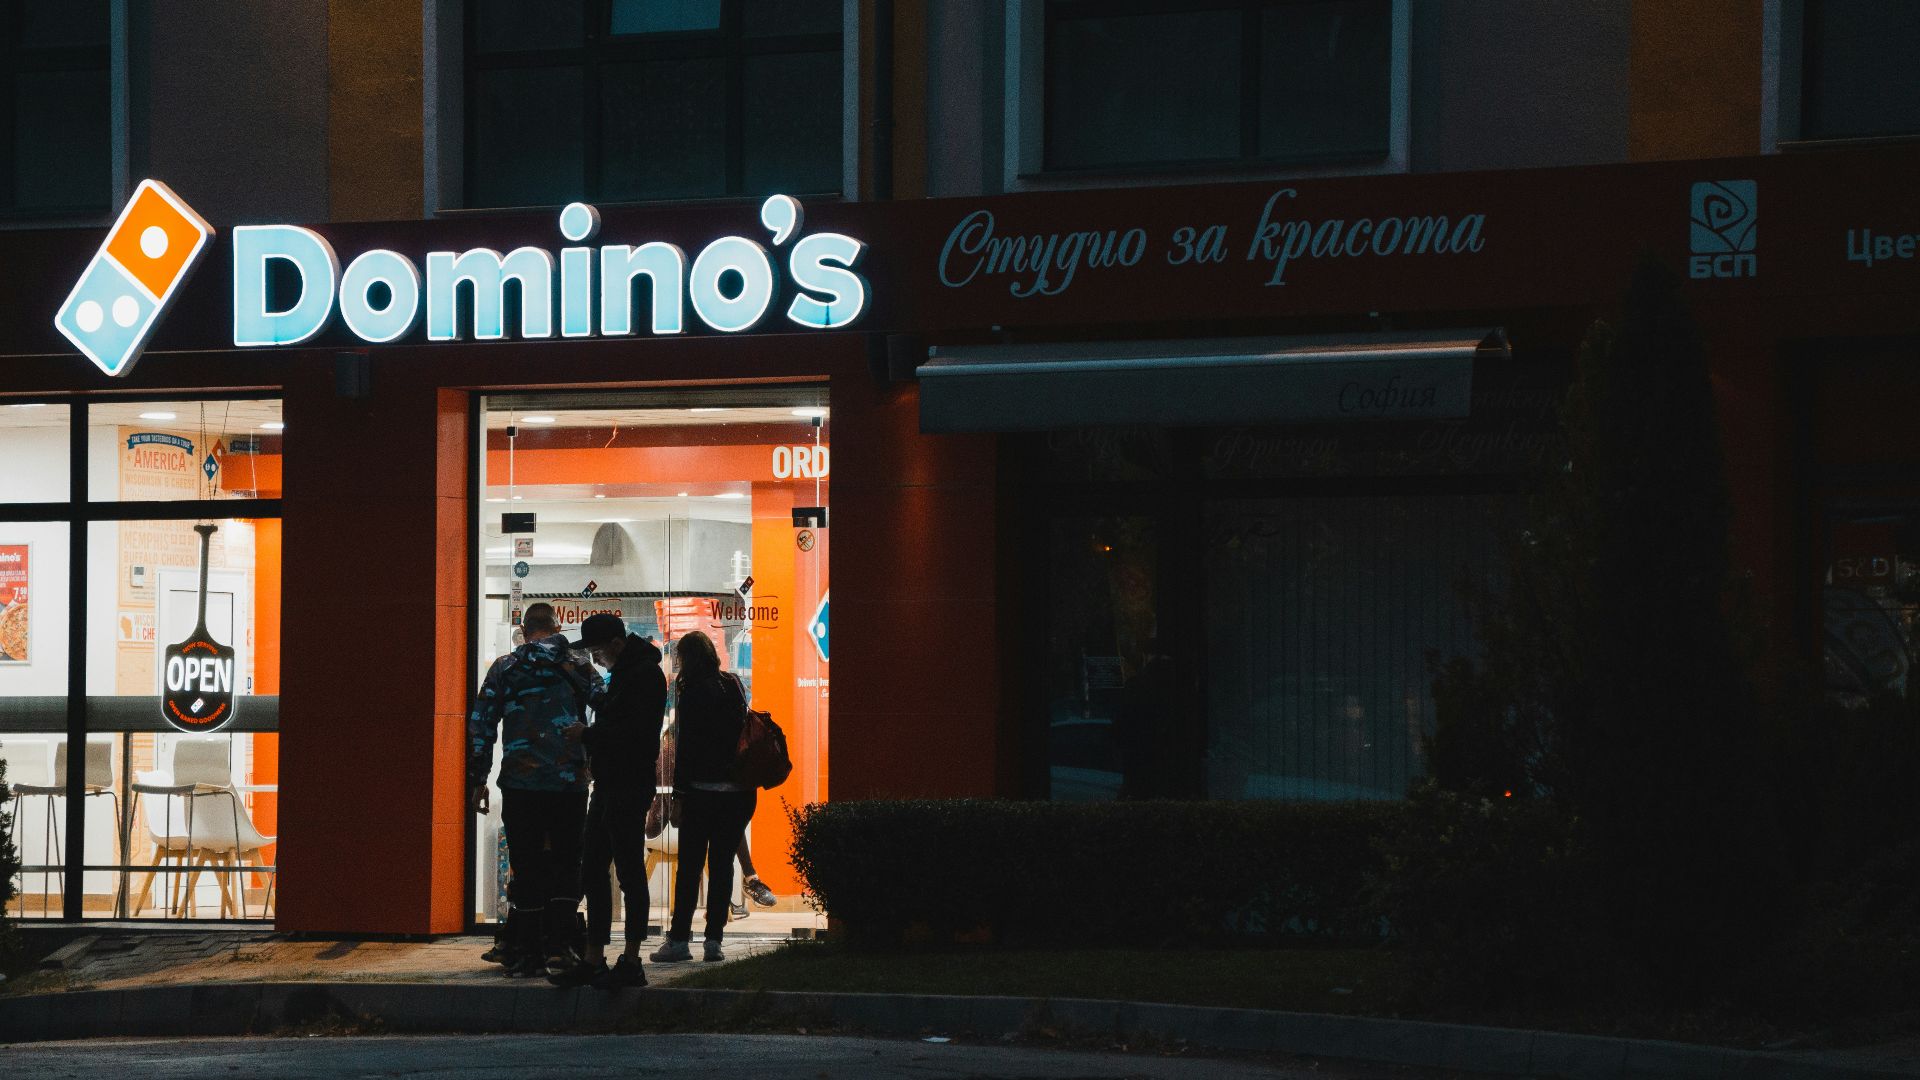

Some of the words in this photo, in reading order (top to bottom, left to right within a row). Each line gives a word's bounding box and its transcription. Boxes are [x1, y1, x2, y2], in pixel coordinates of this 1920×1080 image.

[938, 209, 1148, 298] Студио
[1166, 223, 1229, 266] за
[1246, 188, 1487, 286] красота
[1846, 226, 1920, 269] Цве
[233, 194, 868, 346] Domino's
[1688, 254, 1758, 280] БСП
[1338, 375, 1437, 414] София
[133, 447, 188, 472] AMERICA
[711, 601, 779, 622] Welcome
[166, 655, 232, 692] OPEN
